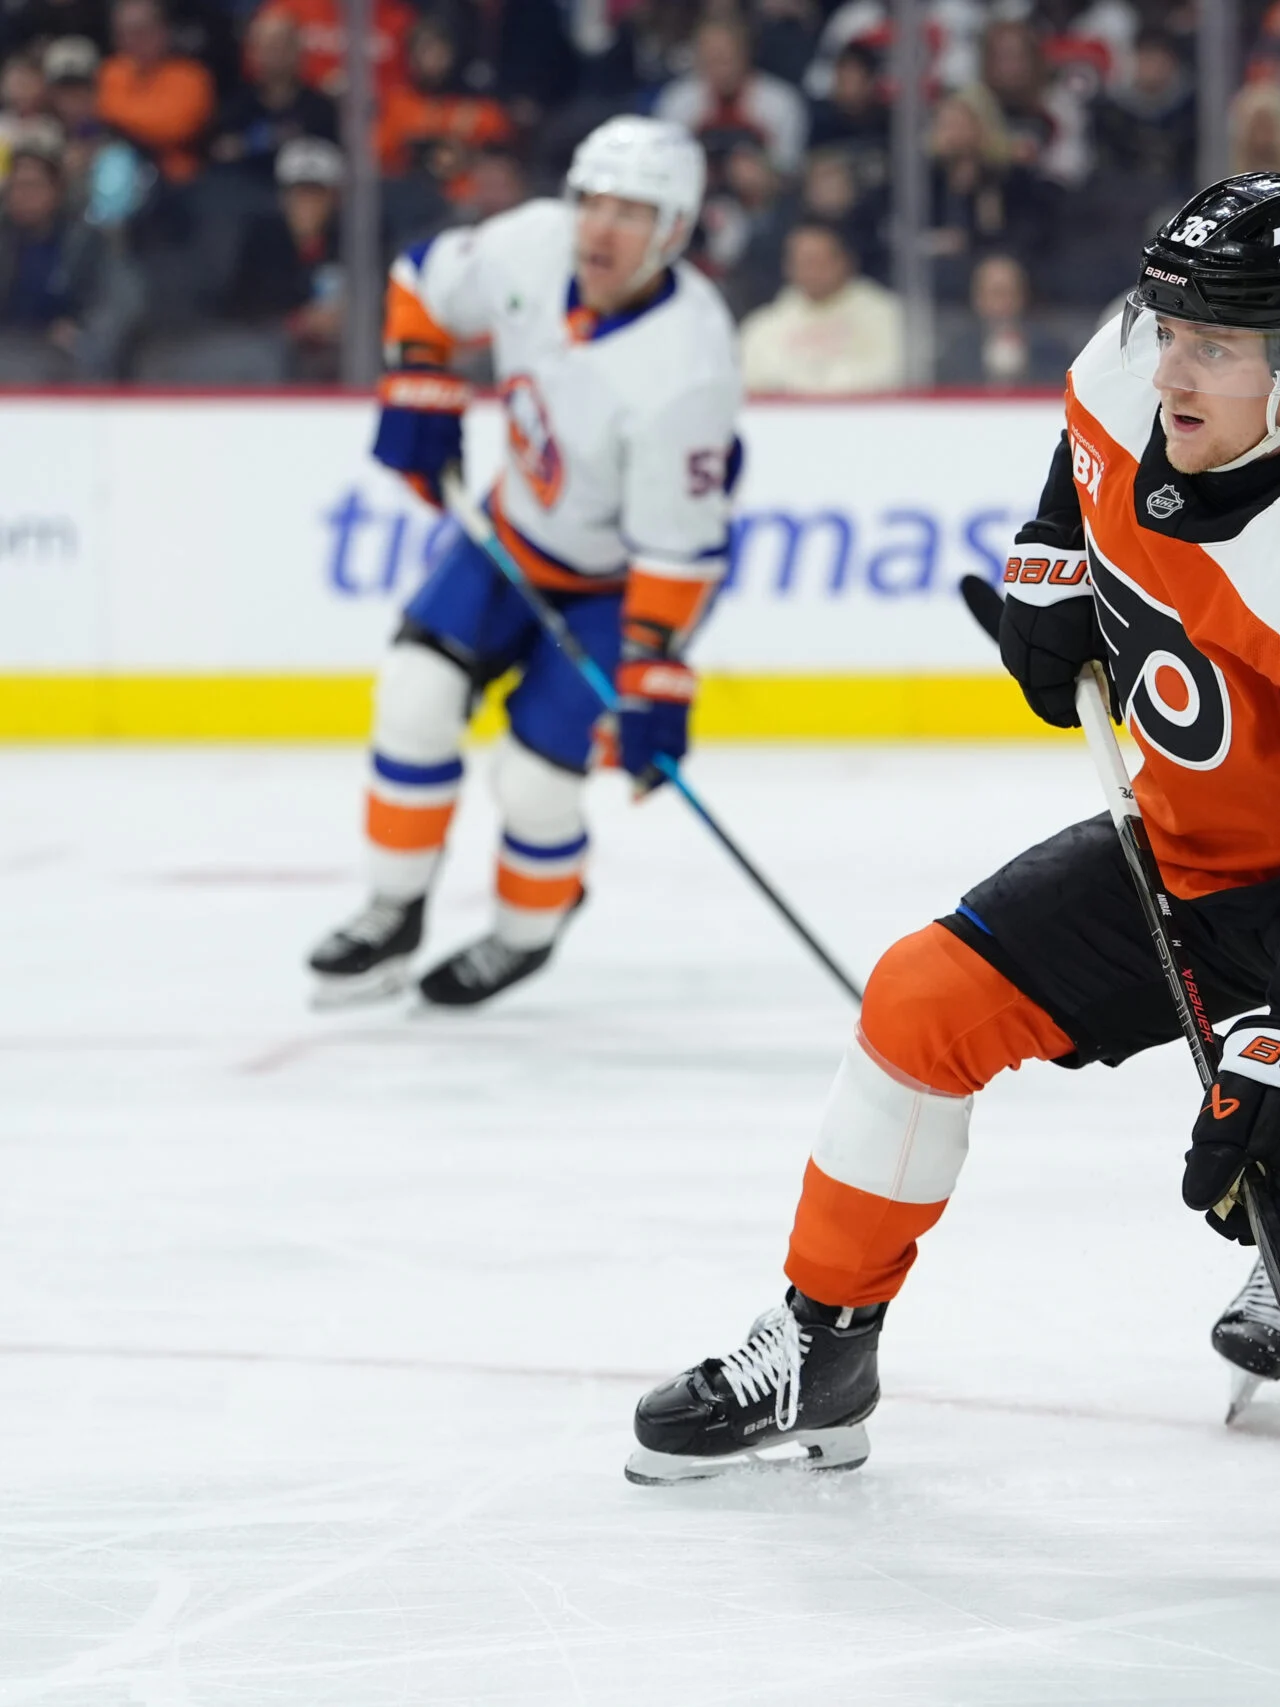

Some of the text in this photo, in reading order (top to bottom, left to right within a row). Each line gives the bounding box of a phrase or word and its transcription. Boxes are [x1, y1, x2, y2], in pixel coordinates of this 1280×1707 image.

[1170, 216, 1218, 247] 36
[1152, 497, 1176, 510] NHL
[1003, 557, 1093, 586] BAU
[1118, 786, 1135, 800] 36
